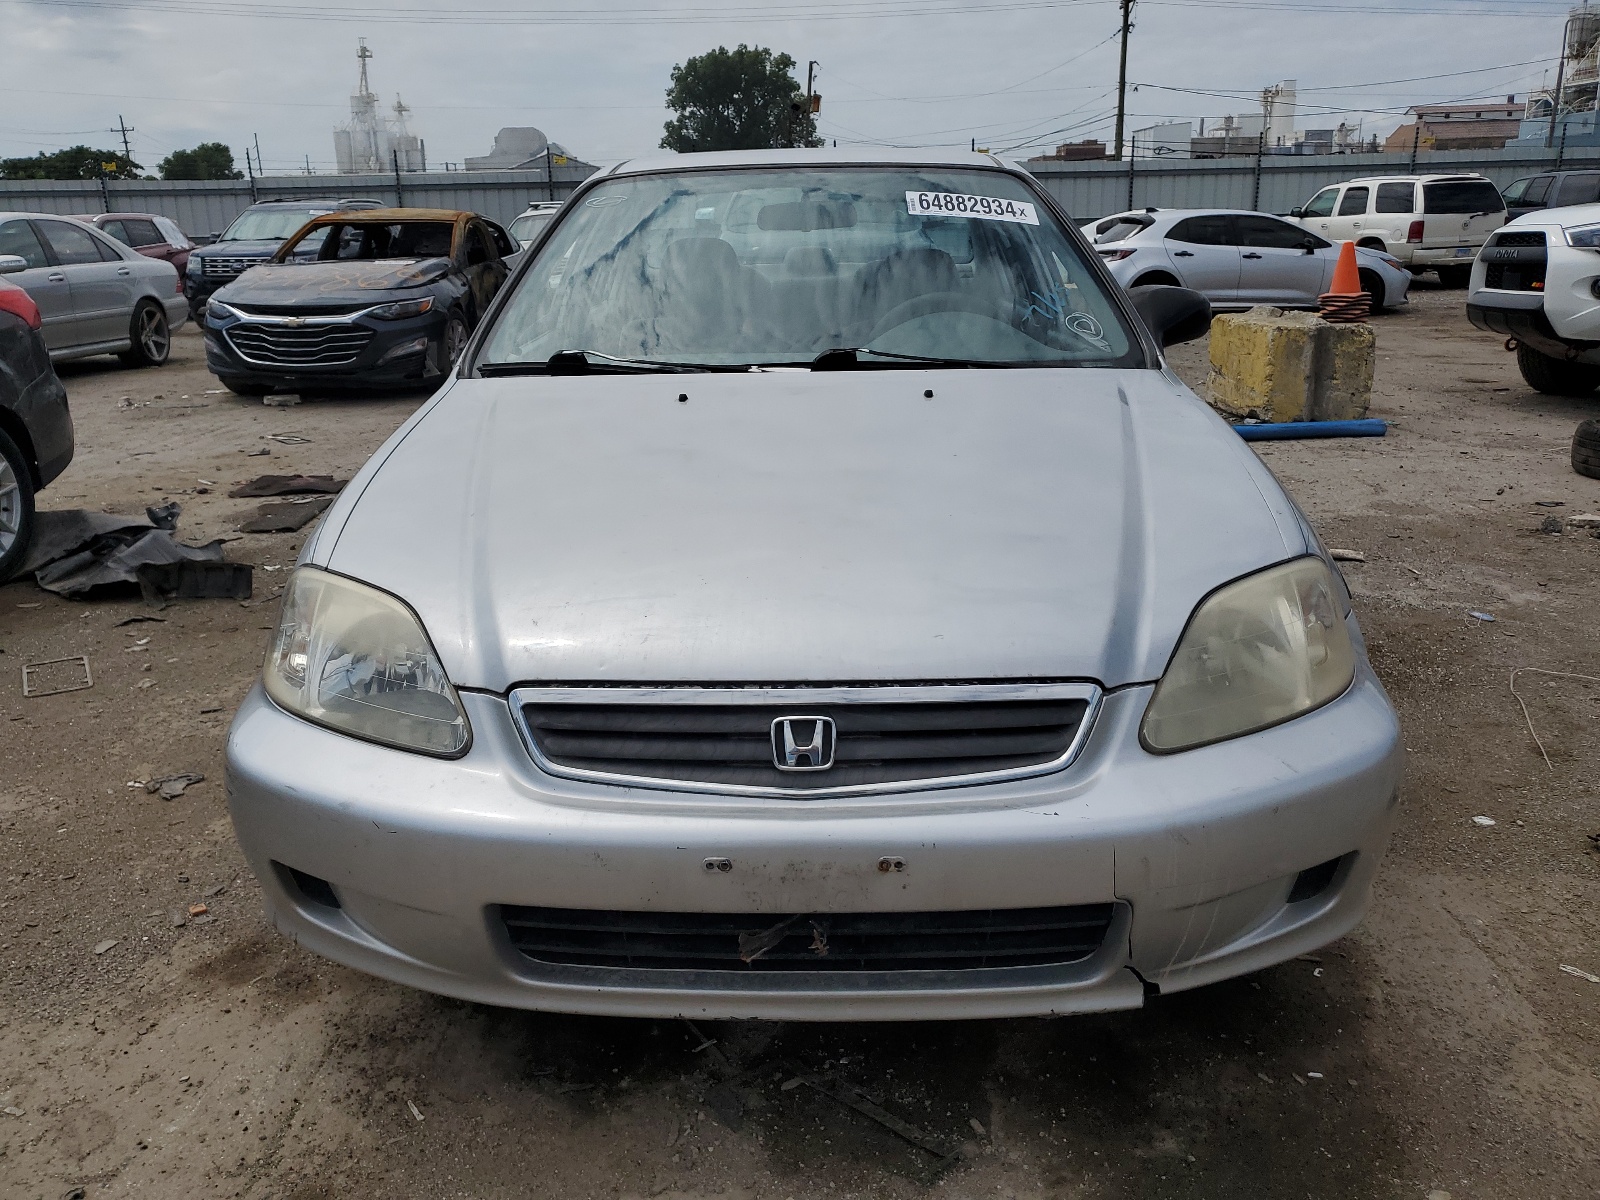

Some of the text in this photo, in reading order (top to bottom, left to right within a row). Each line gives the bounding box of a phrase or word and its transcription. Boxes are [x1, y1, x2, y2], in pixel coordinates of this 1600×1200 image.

[918, 192, 1017, 217] 64882934
[1494, 249, 1519, 258] TOYOTA
[782, 718, 825, 768] H
